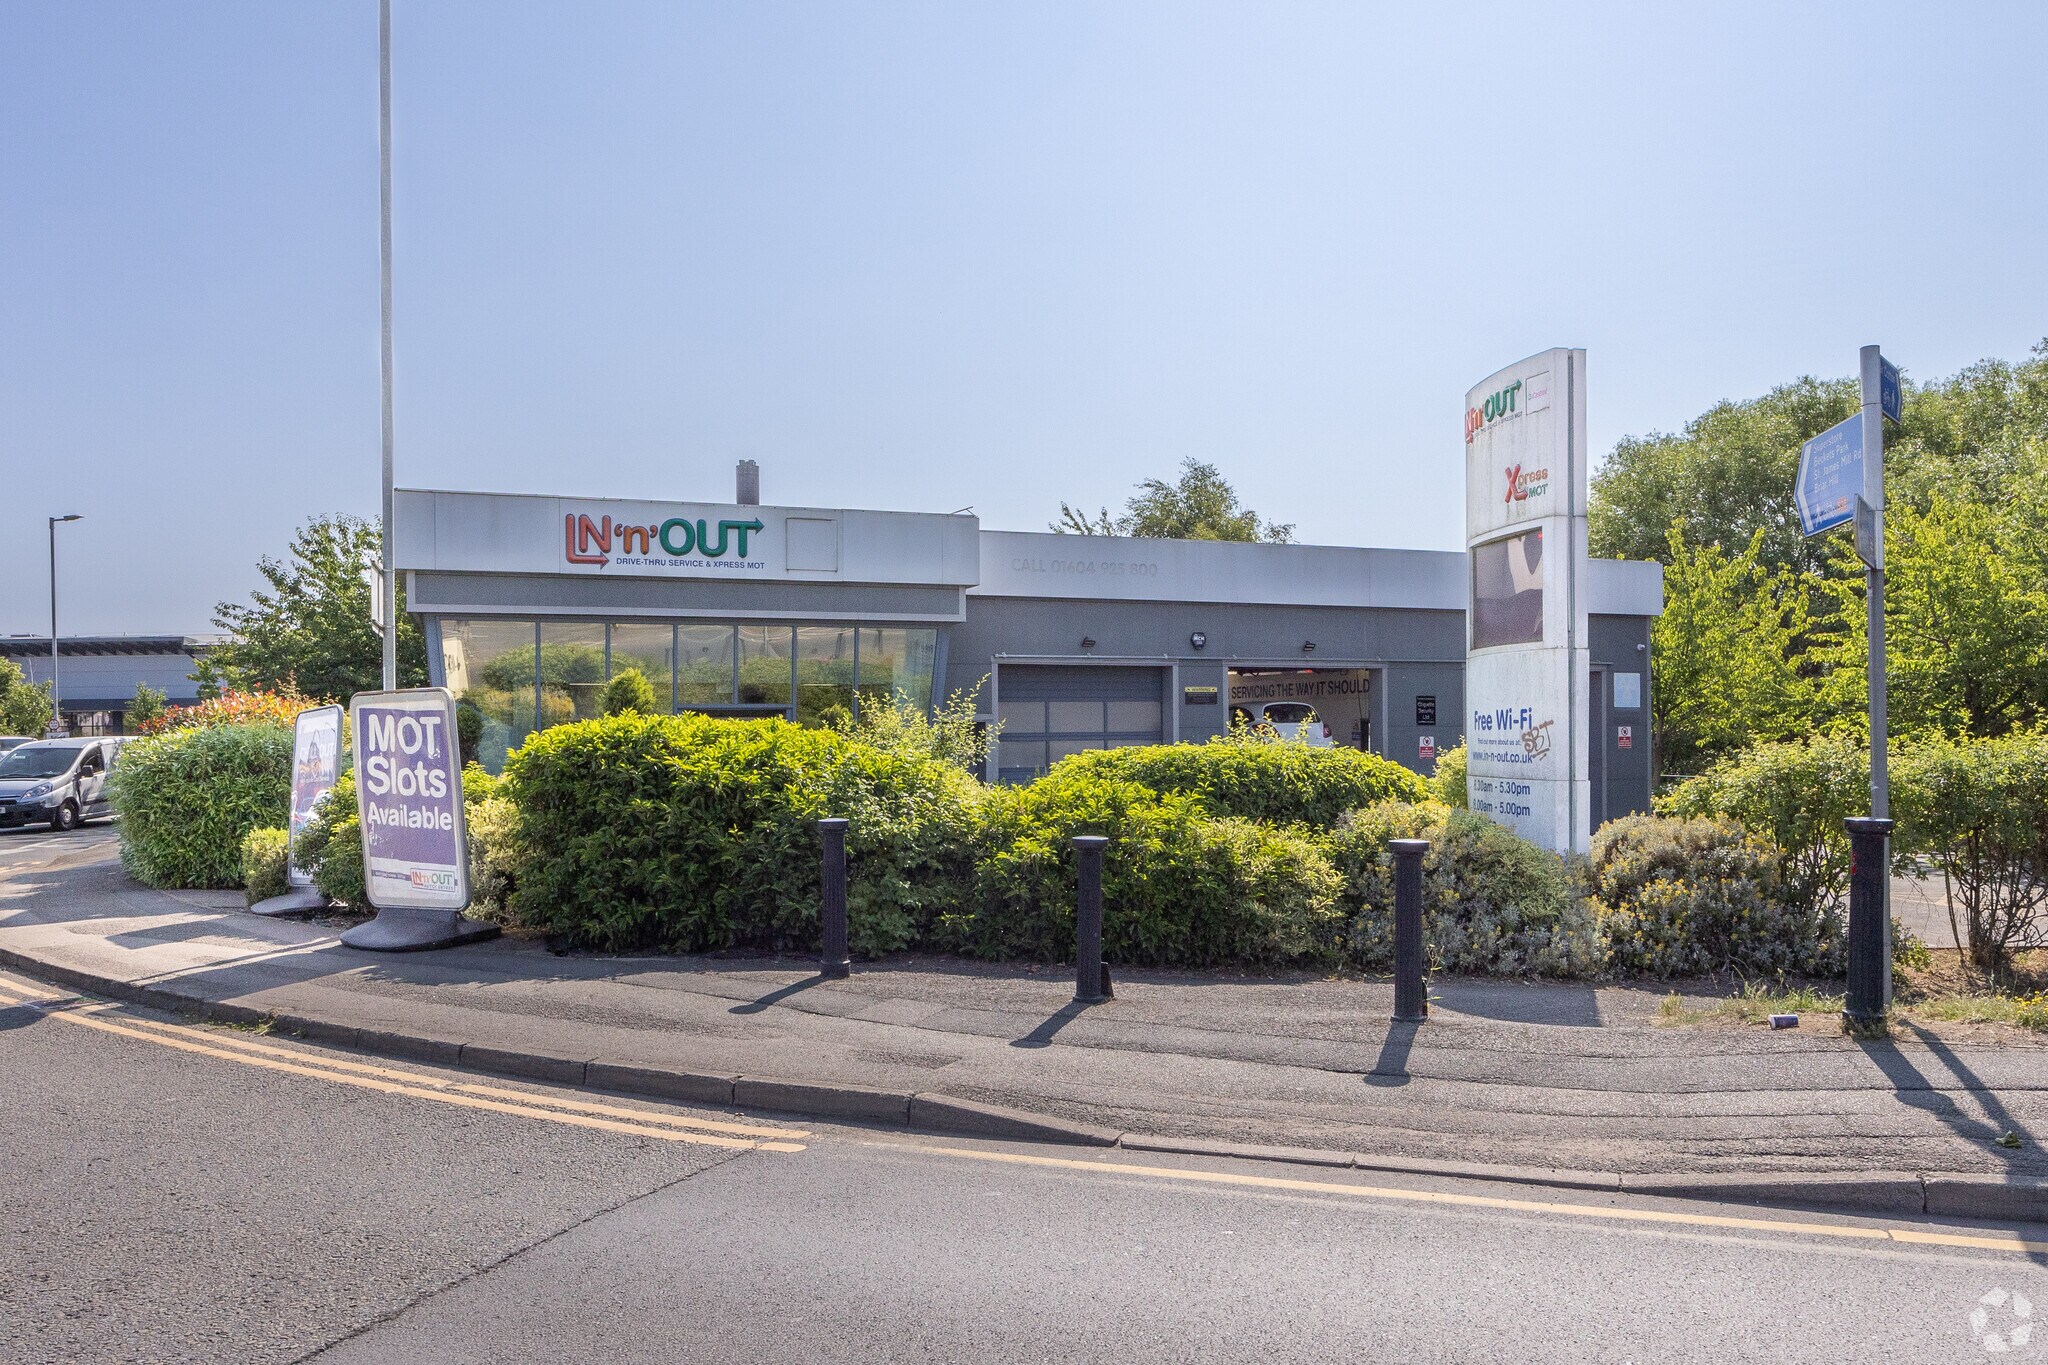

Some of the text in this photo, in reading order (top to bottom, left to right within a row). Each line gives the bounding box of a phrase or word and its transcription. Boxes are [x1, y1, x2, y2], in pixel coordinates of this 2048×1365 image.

[1528, 483, 1549, 498] MOT
[616, 557, 765, 570] DRIVE-THRU SERVICE & XPRESS MOT
[1011, 558, 1046, 573] CALL
[1051, 559, 1096, 575] 01604
[1130, 562, 1158, 577] 800
[1231, 685, 1275, 699] SERVICING
[1277, 683, 1294, 697] THE
[1295, 682, 1315, 695] WAY
[1316, 681, 1326, 695] IT
[1328, 679, 1371, 695] SHOULD
[1474, 707, 1532, 731] Free Wi-Fi
[368, 713, 441, 756] MOT
[366, 755, 447, 799] Slots
[1499, 781, 1531, 797] 5.30pm
[367, 802, 453, 831] Available
[1499, 801, 1531, 818] 5.00pm
